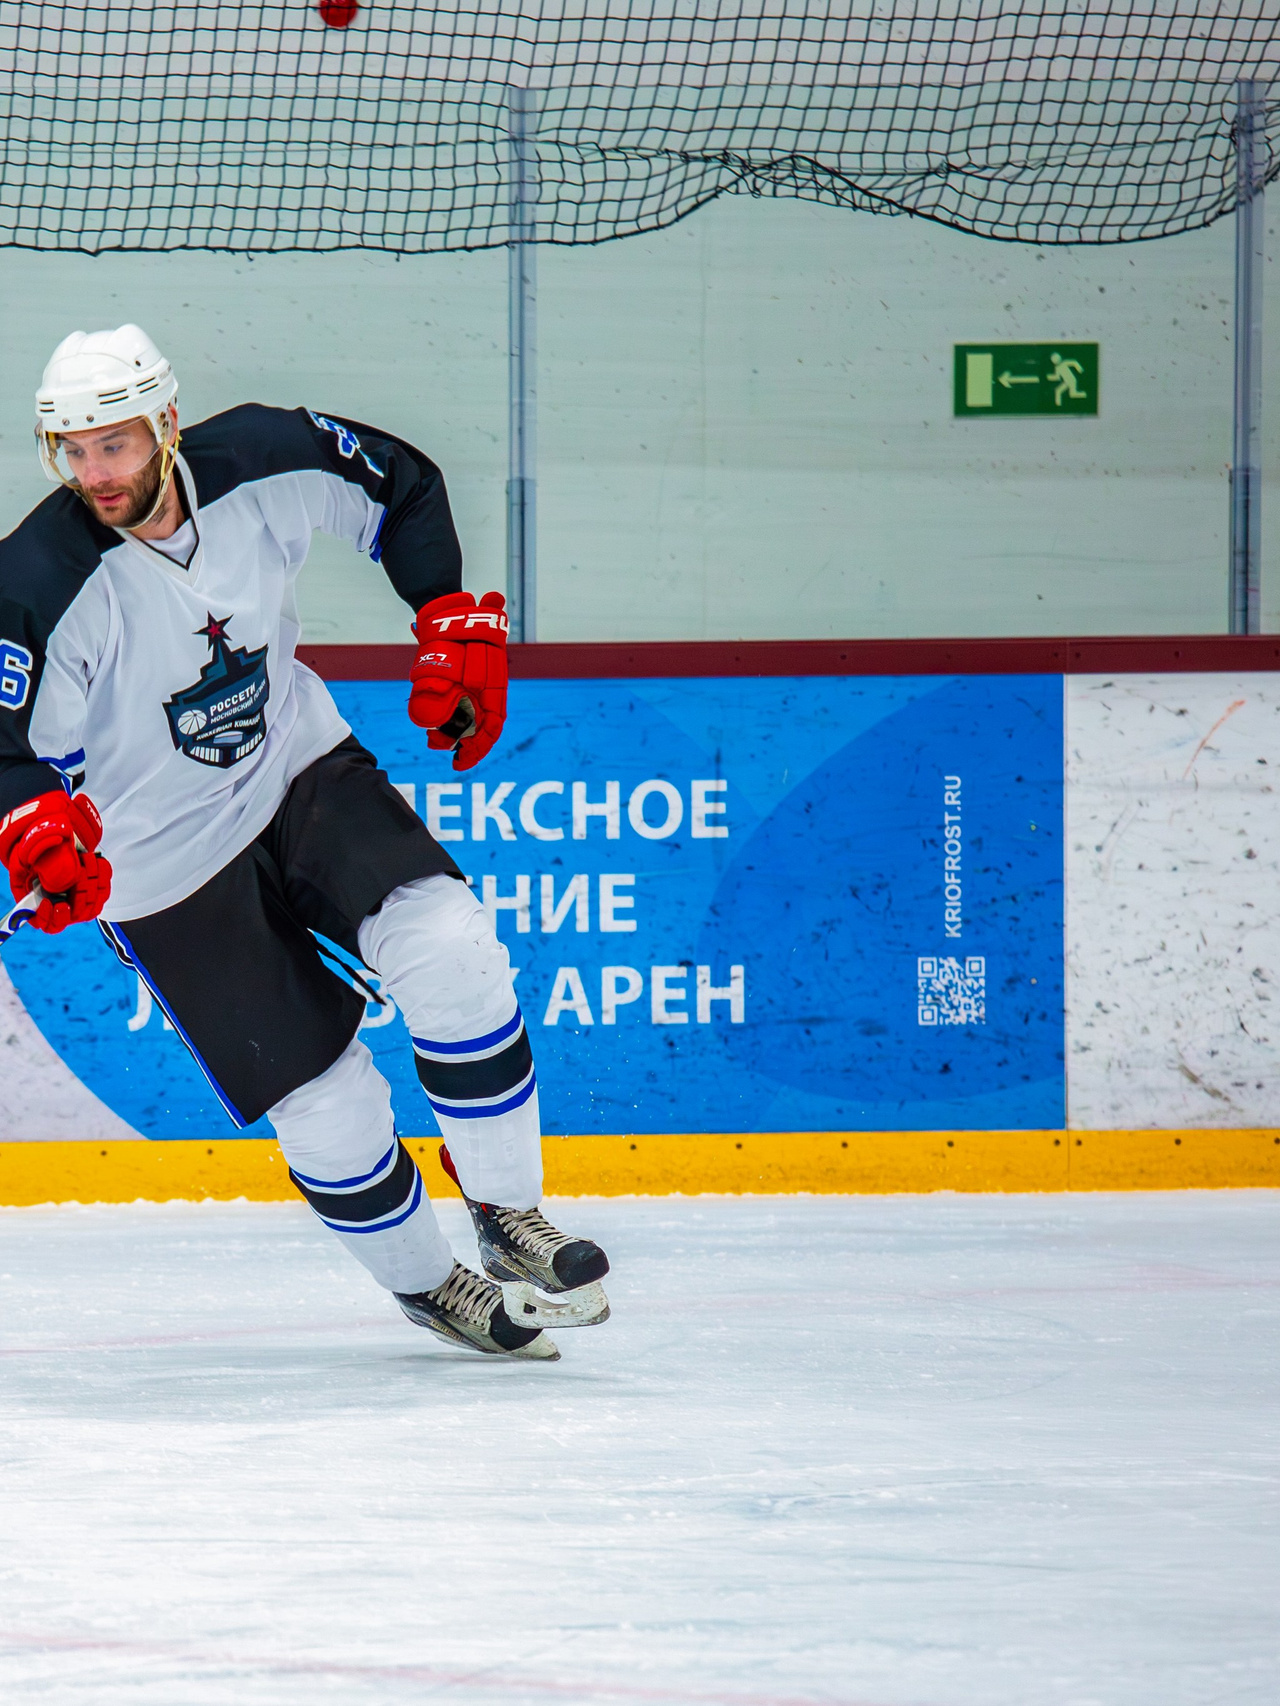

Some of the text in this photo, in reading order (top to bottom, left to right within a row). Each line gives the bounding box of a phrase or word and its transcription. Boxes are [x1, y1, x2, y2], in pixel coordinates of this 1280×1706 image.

[209, 681, 256, 717] РОССЕТИ
[943, 775, 962, 938] KRIOFROST.RU
[466, 874, 638, 933] НИЕ
[543, 965, 746, 1026] АРЕН
